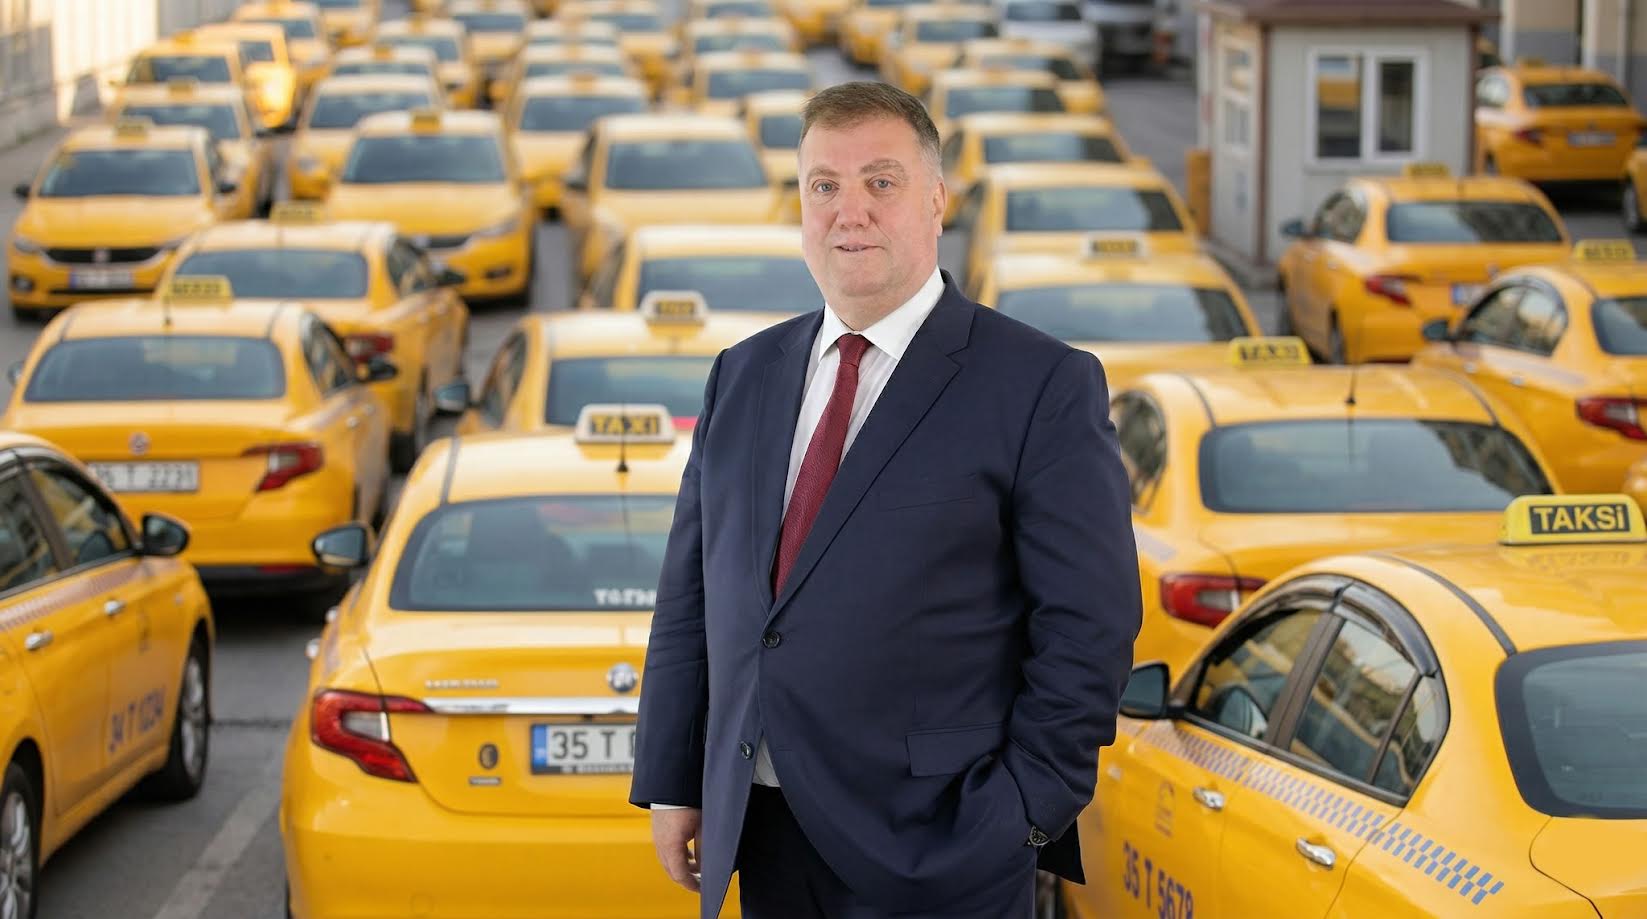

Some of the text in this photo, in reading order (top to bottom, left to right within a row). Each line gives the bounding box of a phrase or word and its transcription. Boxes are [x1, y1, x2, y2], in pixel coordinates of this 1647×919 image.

[591, 414, 658, 434] TAXI
[552, 731, 588, 760] 35
[601, 731, 615, 759] T
[1123, 841, 1140, 899] 35
[1144, 857, 1153, 911] T
